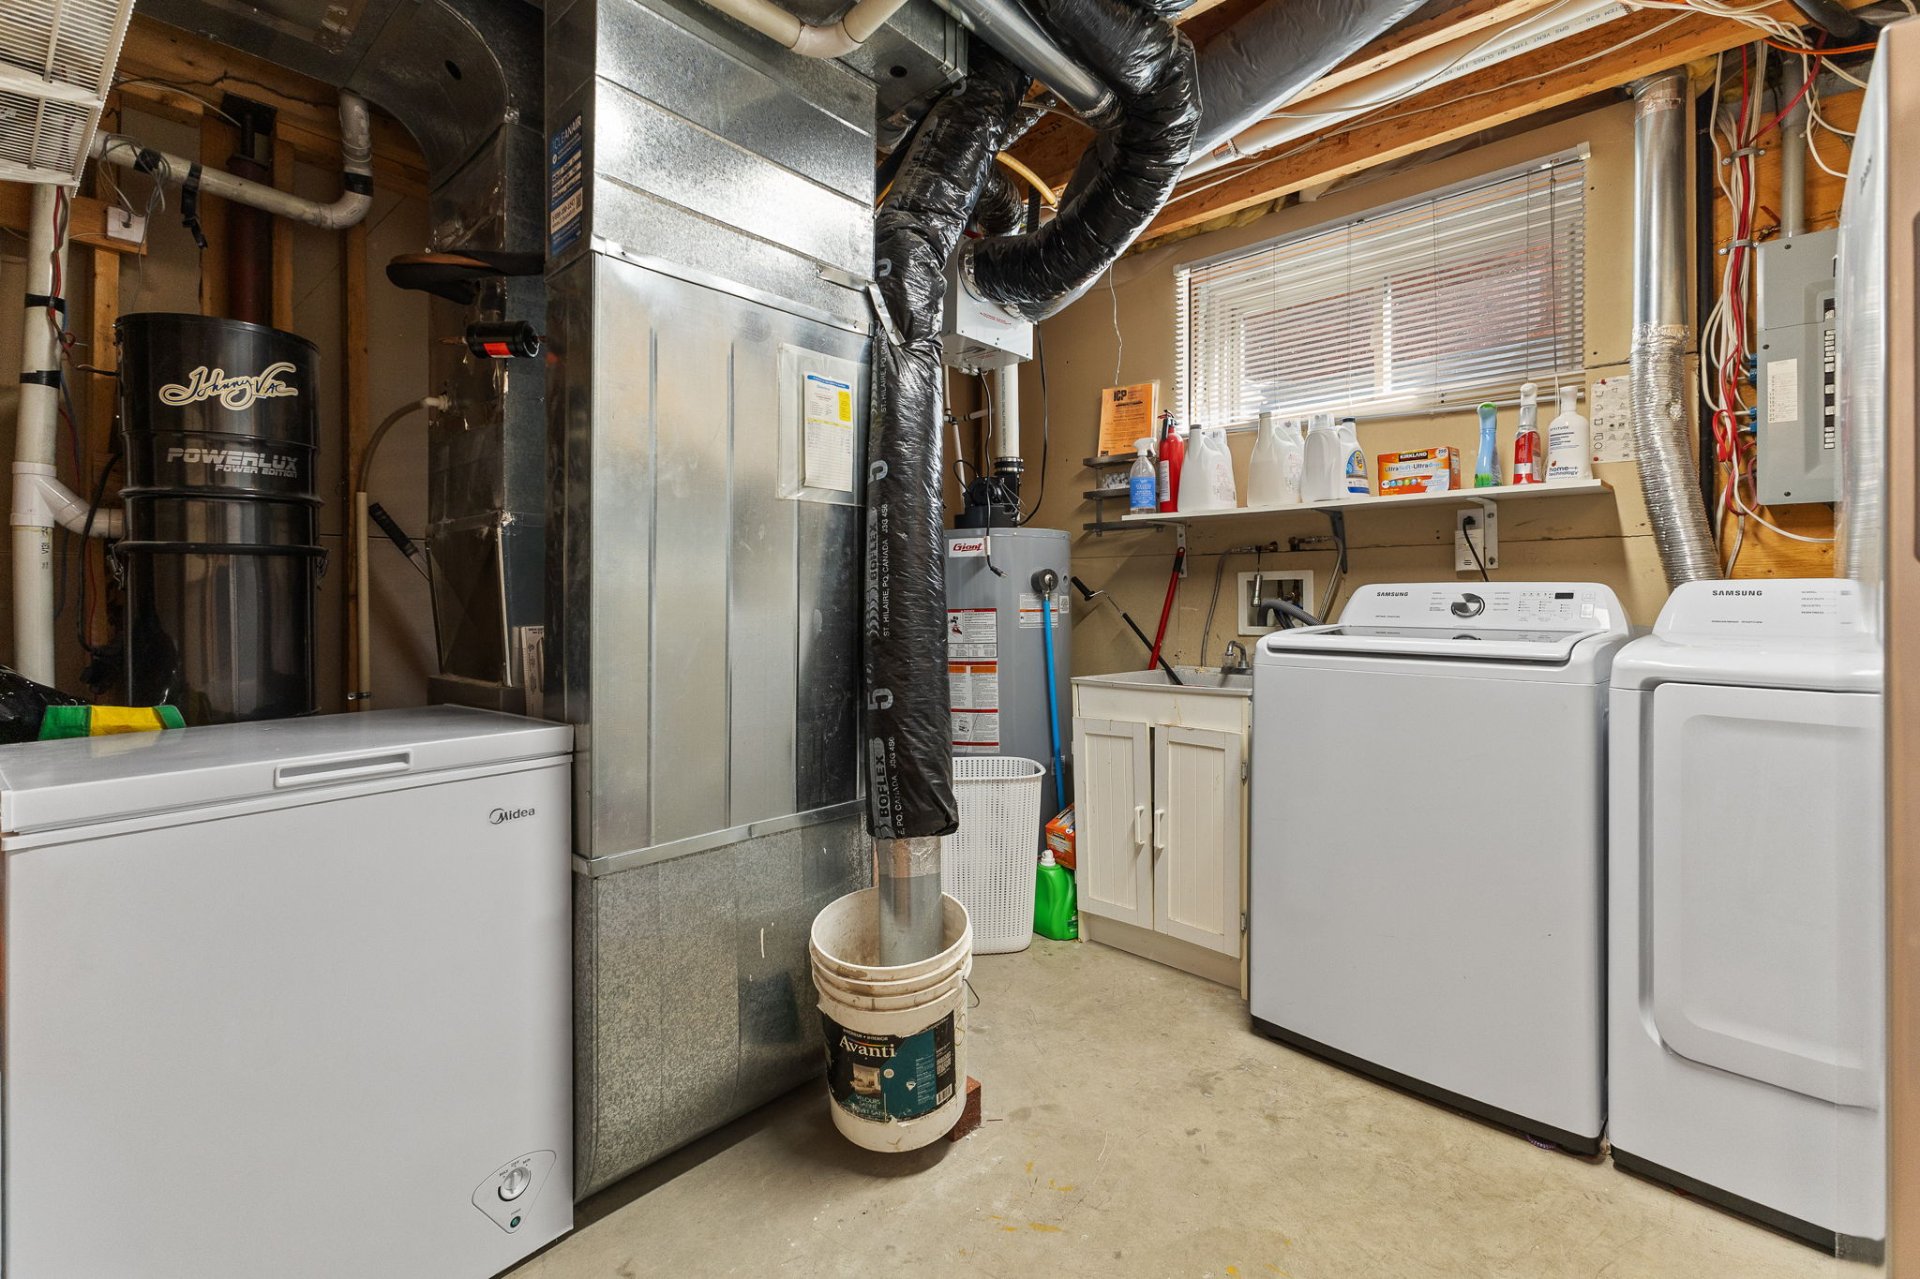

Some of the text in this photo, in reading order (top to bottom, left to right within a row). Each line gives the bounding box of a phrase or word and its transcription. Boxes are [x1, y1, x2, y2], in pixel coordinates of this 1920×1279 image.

[166, 447, 298, 472] POWERLUX
[1400, 451, 1427, 459] KIRKLAND
[215, 463, 297, 479] POWER EDITION
[870, 523, 878, 581] BOFLEX
[881, 539, 889, 573] CANADA
[953, 543, 982, 552] Giant
[875, 755, 890, 818] BOFLEX
[489, 808, 535, 825] Midea
[840, 1035, 897, 1058] Avanti
